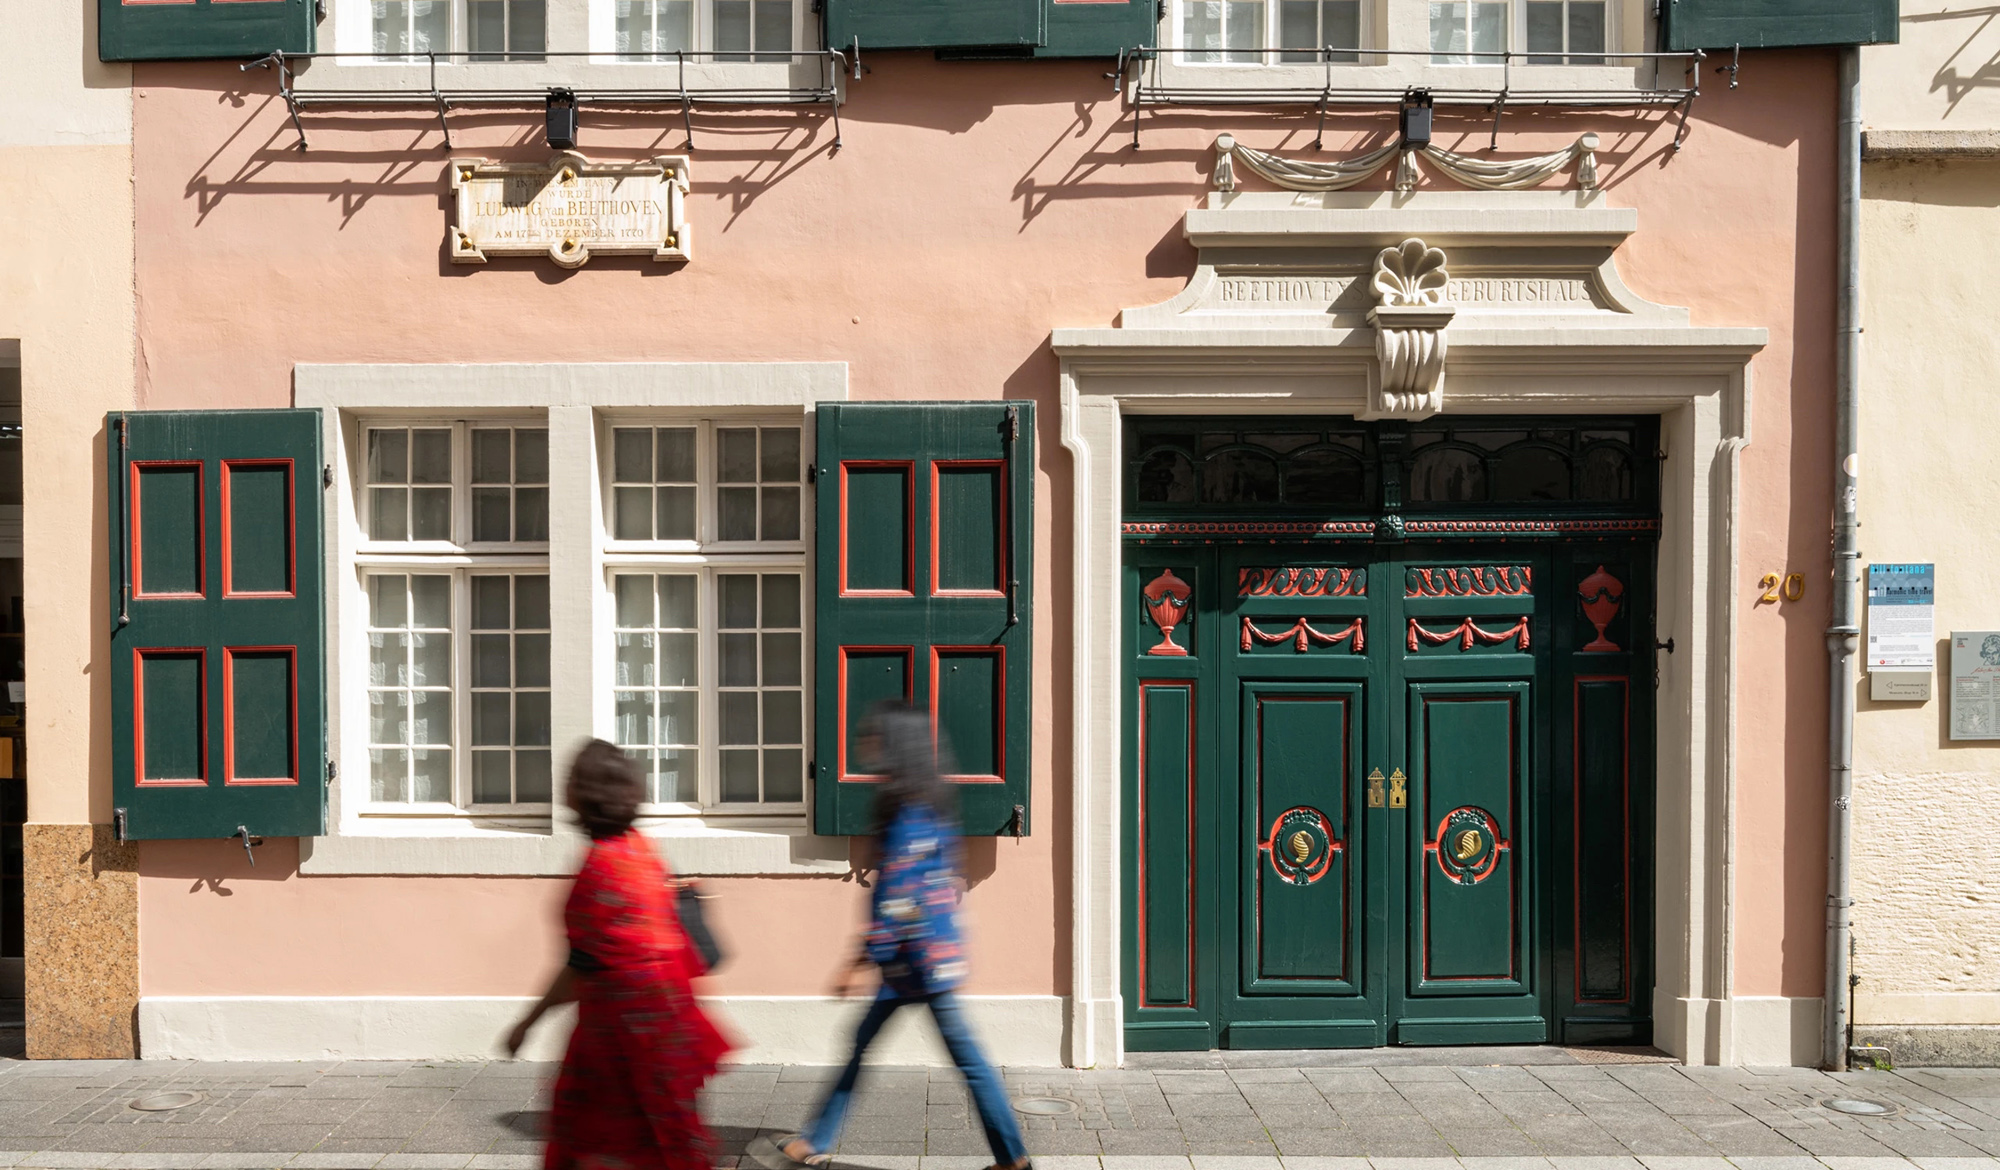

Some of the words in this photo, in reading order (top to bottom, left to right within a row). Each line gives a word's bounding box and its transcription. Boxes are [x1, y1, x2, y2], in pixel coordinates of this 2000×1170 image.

[516, 180, 527, 188] IN
[547, 190, 591, 198] WURDE
[476, 201, 541, 216] LUDWIG
[546, 206, 564, 216] van
[568, 200, 662, 215] BEETHOVEN
[541, 218, 598, 227] GEBOREN
[495, 230, 512, 238] AM
[547, 229, 615, 238] DEZEMBER
[621, 229, 644, 238] 1770
[1221, 280, 1365, 301] BEETHOVENS
[1446, 280, 1592, 301] GEBURTSHAUS
[1763, 572, 1805, 602] 20
